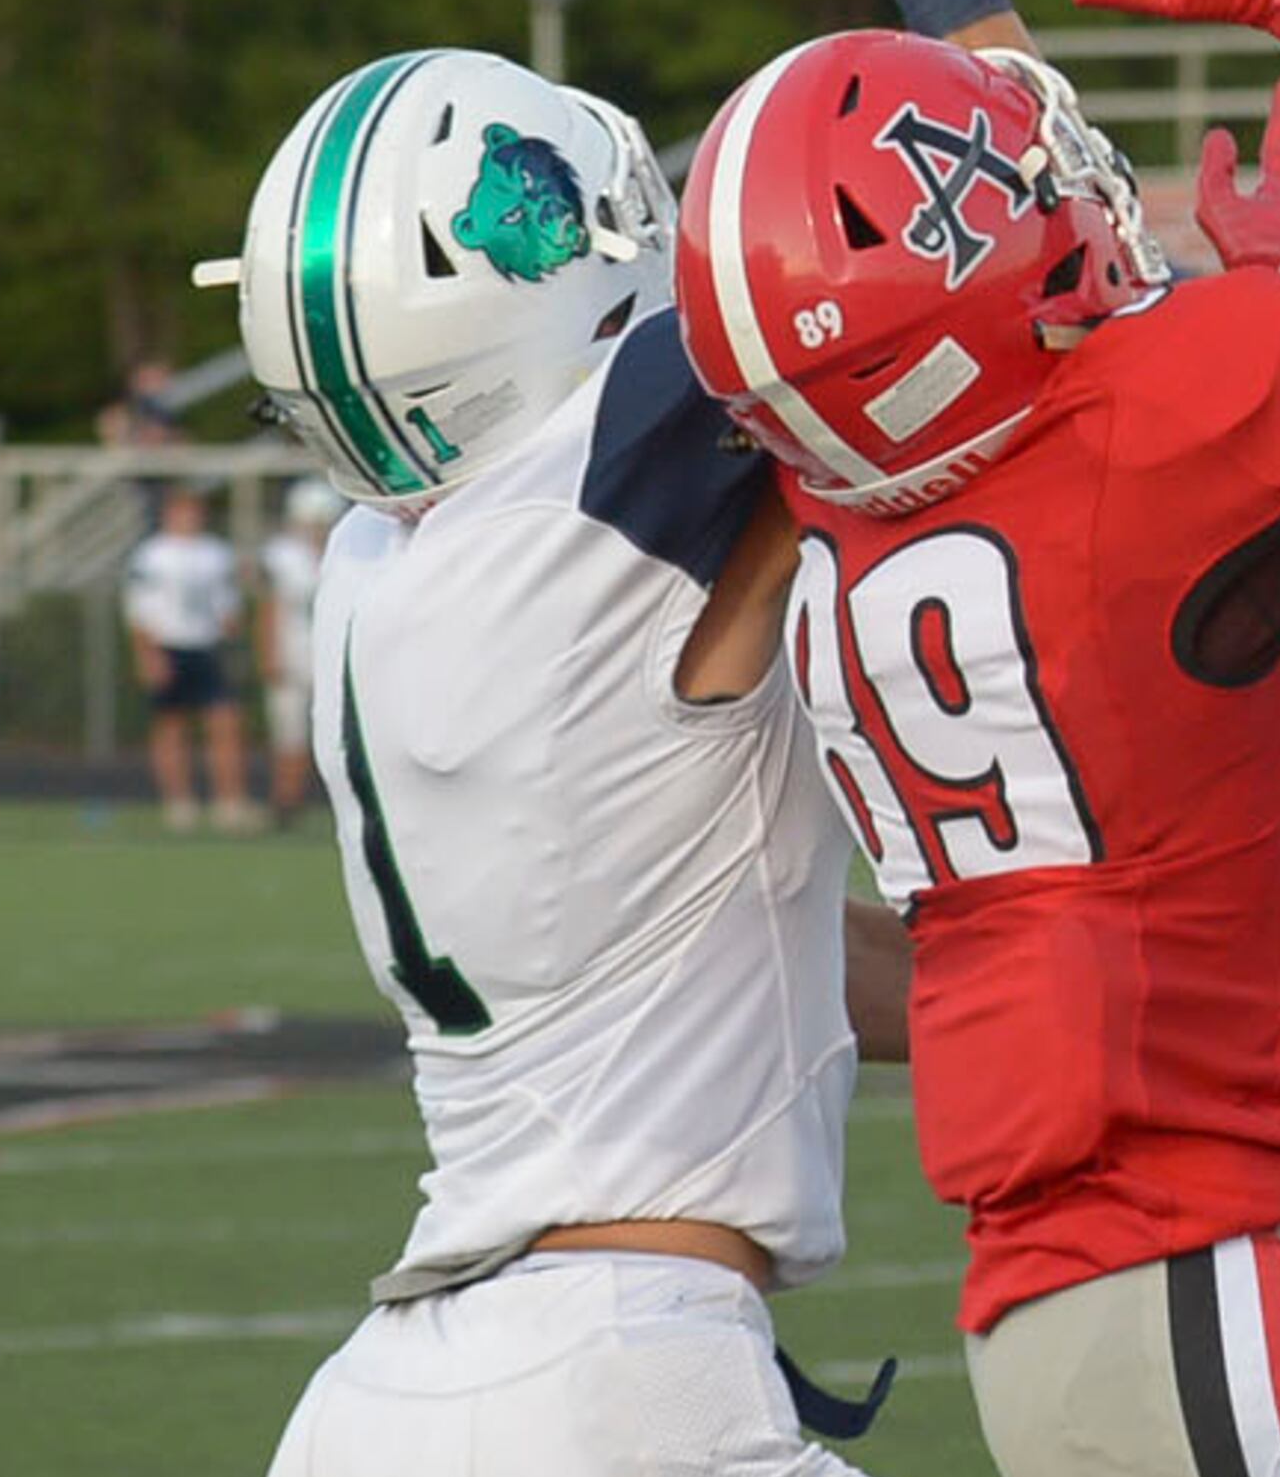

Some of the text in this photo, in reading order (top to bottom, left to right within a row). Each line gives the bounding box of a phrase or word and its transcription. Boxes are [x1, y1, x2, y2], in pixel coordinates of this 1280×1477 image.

[406, 406, 461, 464] 1
[793, 300, 844, 349] 89
[340, 617, 493, 1037] 1
[784, 523, 1104, 925] 89
